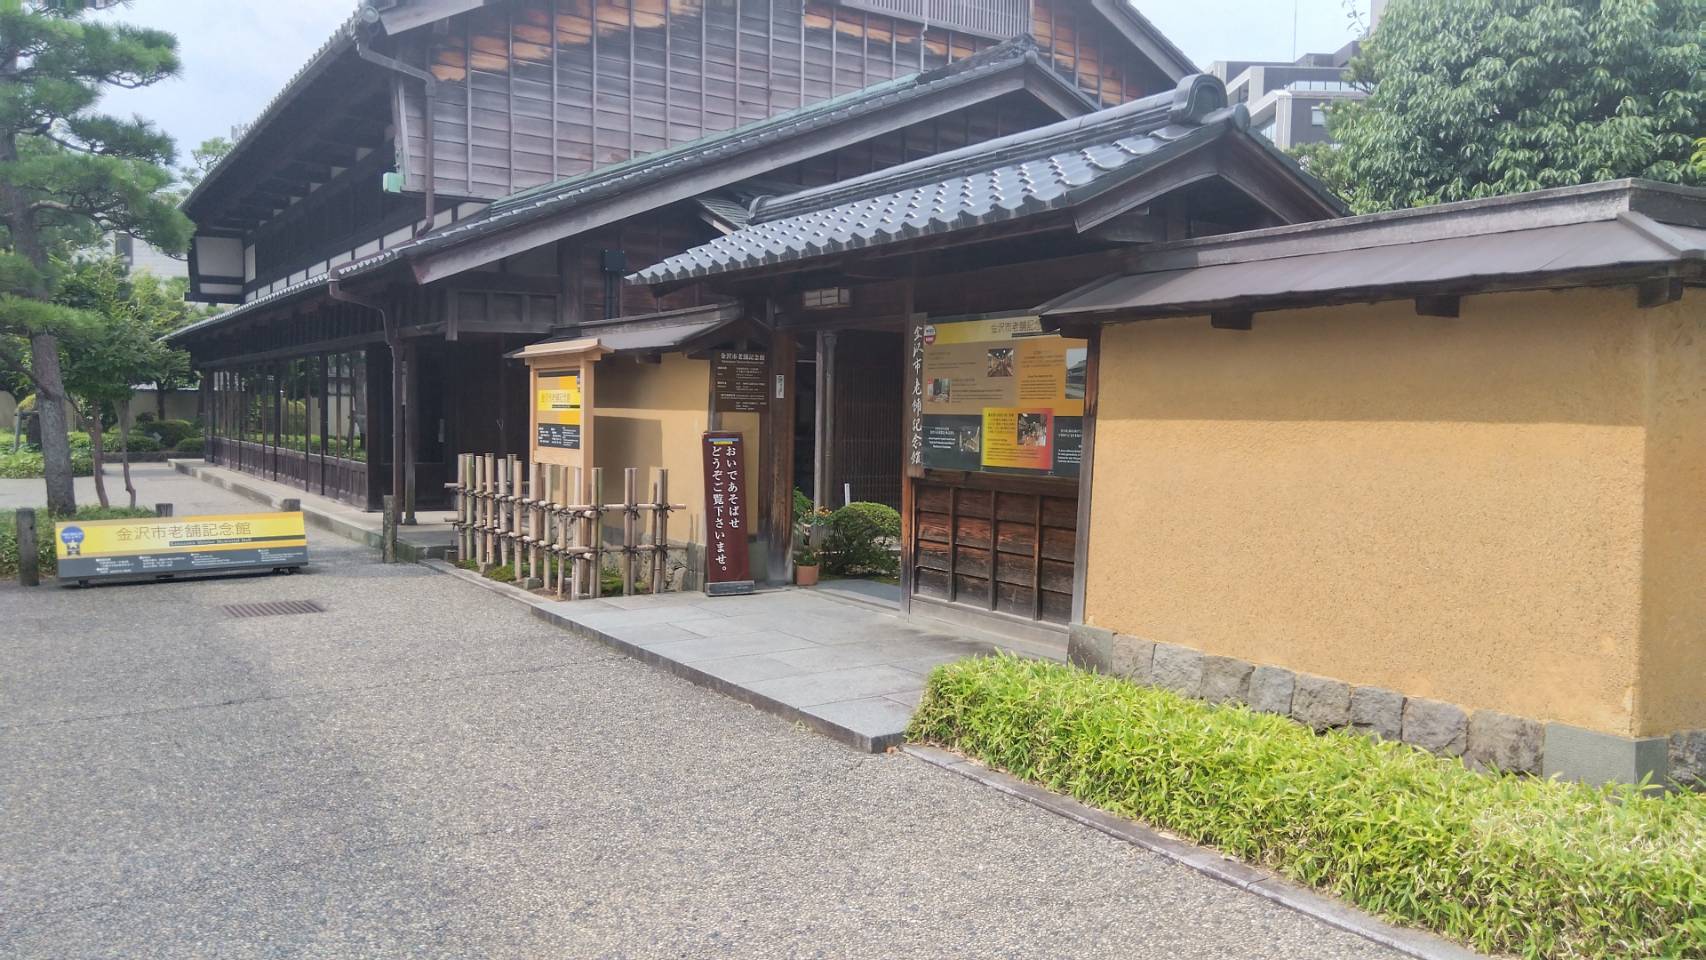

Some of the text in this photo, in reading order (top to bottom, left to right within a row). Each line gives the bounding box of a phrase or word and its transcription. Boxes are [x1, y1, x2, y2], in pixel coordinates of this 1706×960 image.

[711, 446, 727, 571] どうぞご覧下さいませ。
[725, 446, 740, 529] おいであそばせ
[116, 521, 252, 541] 金沢市老舗記念館
